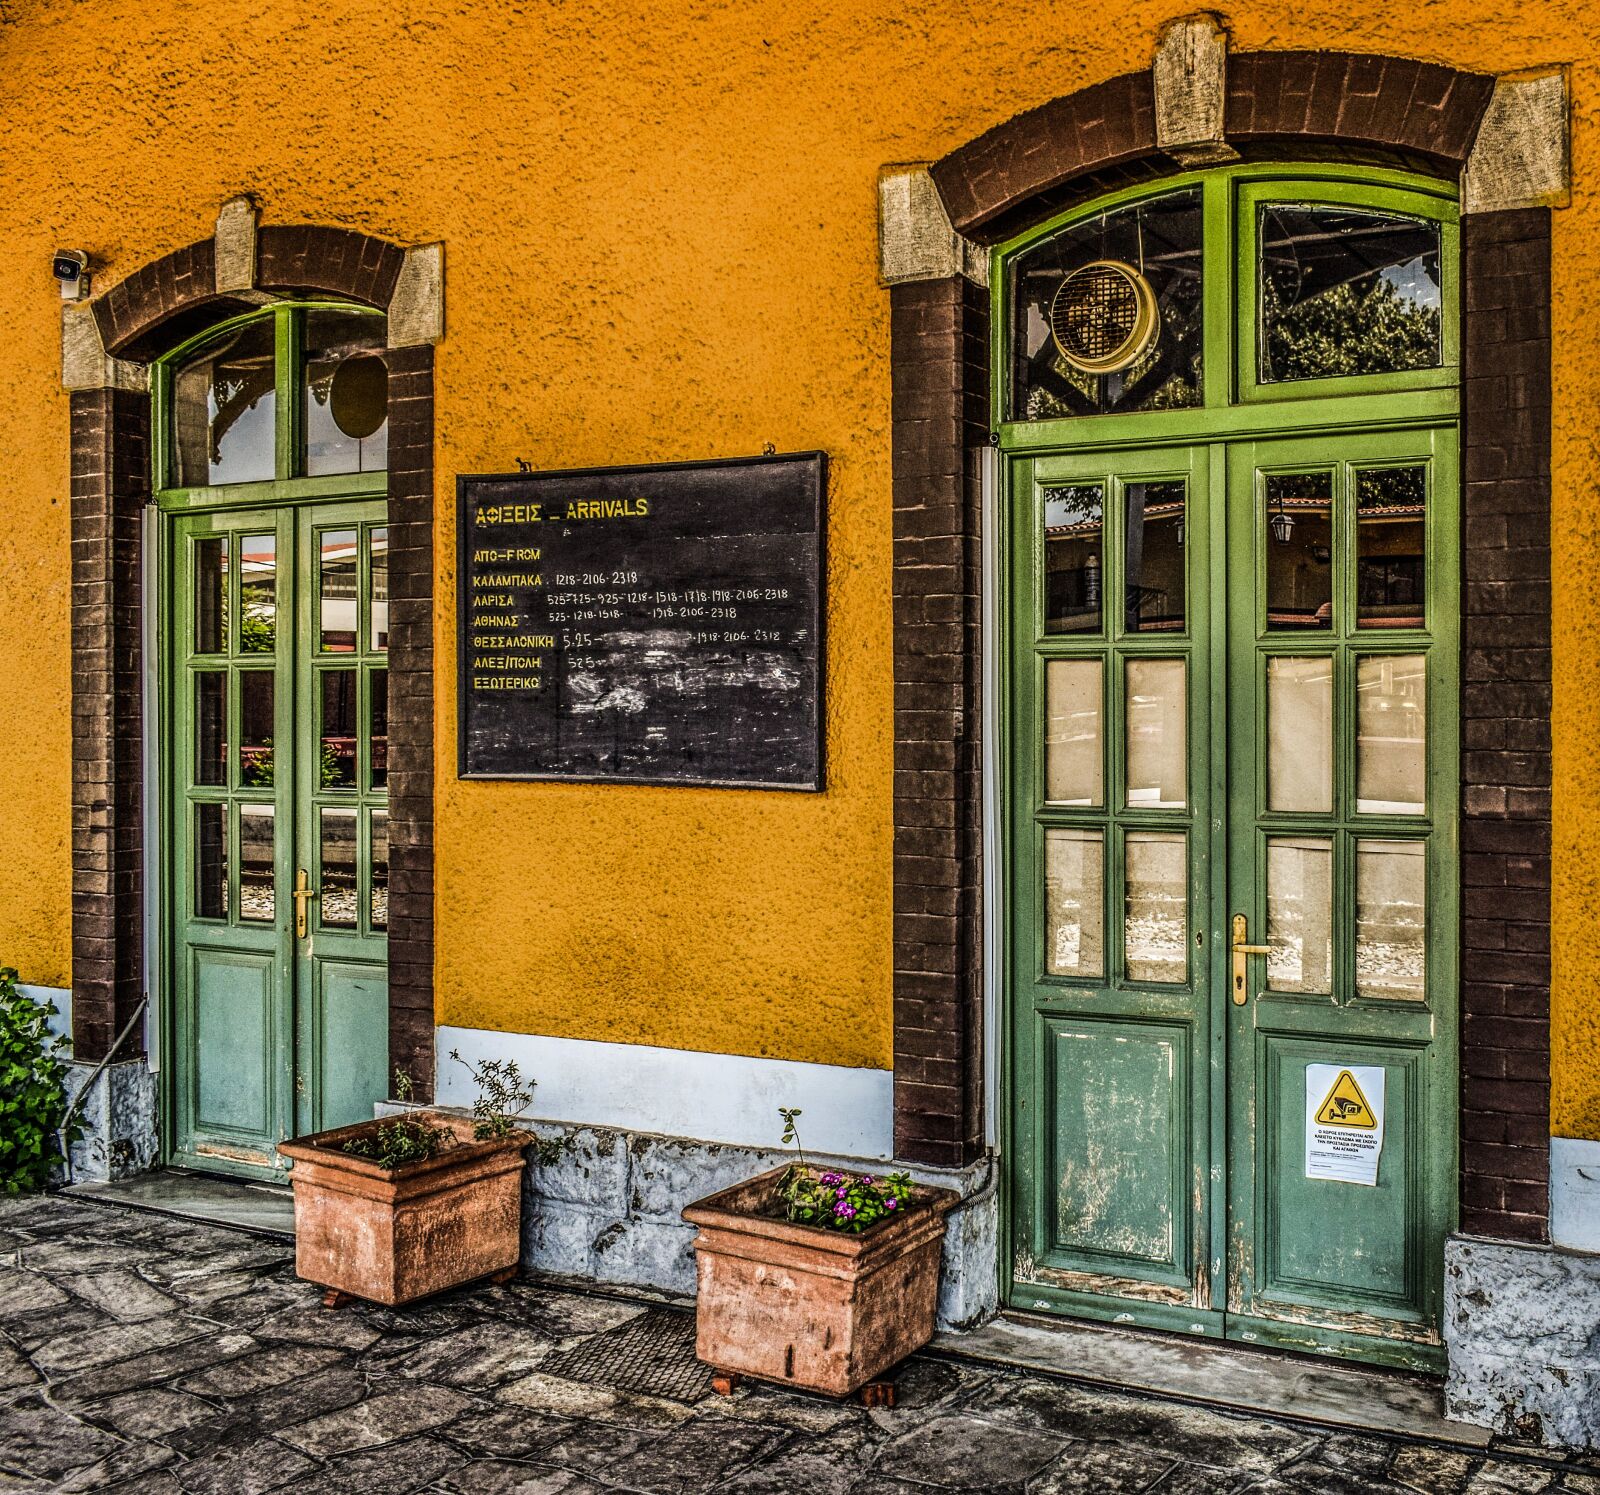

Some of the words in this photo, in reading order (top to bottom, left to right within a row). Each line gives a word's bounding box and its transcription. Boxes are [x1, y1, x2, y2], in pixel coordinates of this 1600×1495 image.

[475, 504, 542, 524] ΑΦΙΞΕΙΣ
[566, 498, 649, 519] ARRIVALS
[473, 574, 543, 588] ΚΑΛΑΜΠΑΚΑ
[473, 594, 515, 607] ΛΑΡΙΣΑ
[474, 615, 519, 627] ΑΘΗΝΑΣ
[474, 635, 555, 648] ΘΕΣΣΑΛΟΝΙΚΗ
[474, 656, 542, 669] ΑΛΕΞ/ΠΟΛΗ
[474, 677, 541, 690] ΕΞΩΤΕΡΙΚΟ
